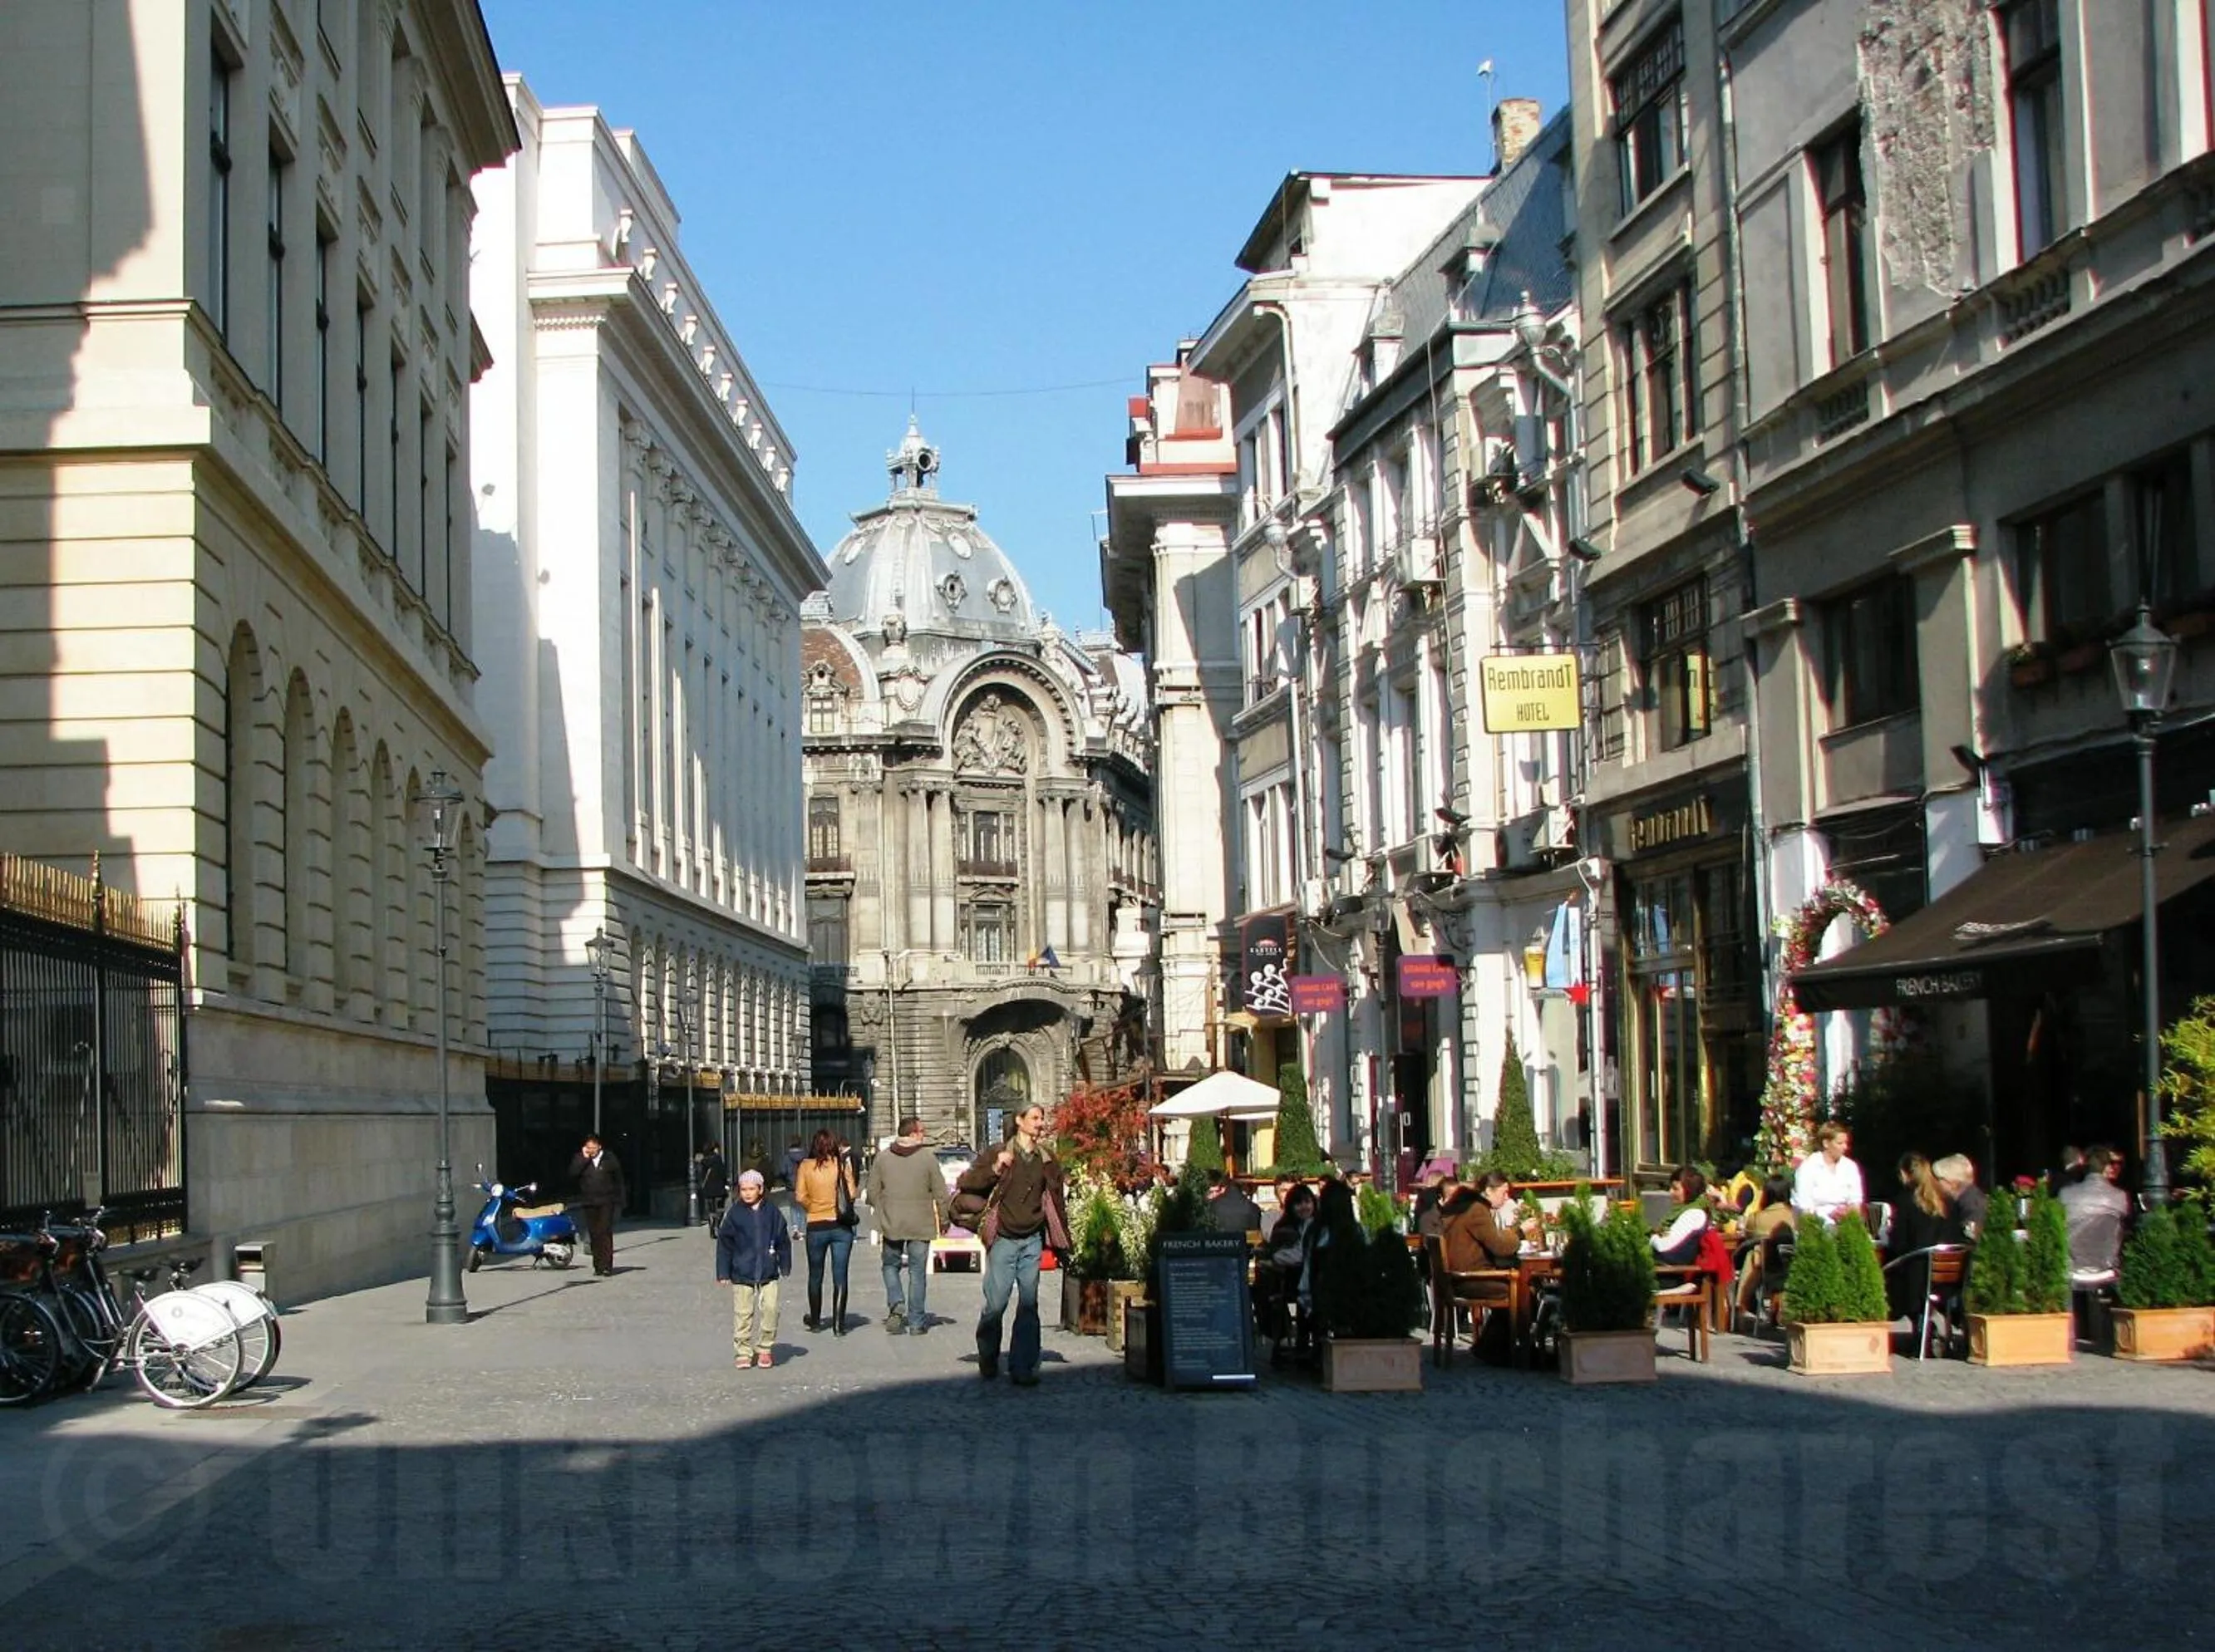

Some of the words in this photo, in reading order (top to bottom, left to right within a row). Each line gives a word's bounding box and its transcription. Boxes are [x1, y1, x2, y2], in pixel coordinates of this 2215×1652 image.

[1517, 702, 1550, 721] HOTEL
[1163, 1239, 1201, 1249] FRENCH
[1204, 1239, 1241, 1248] BAKERY
